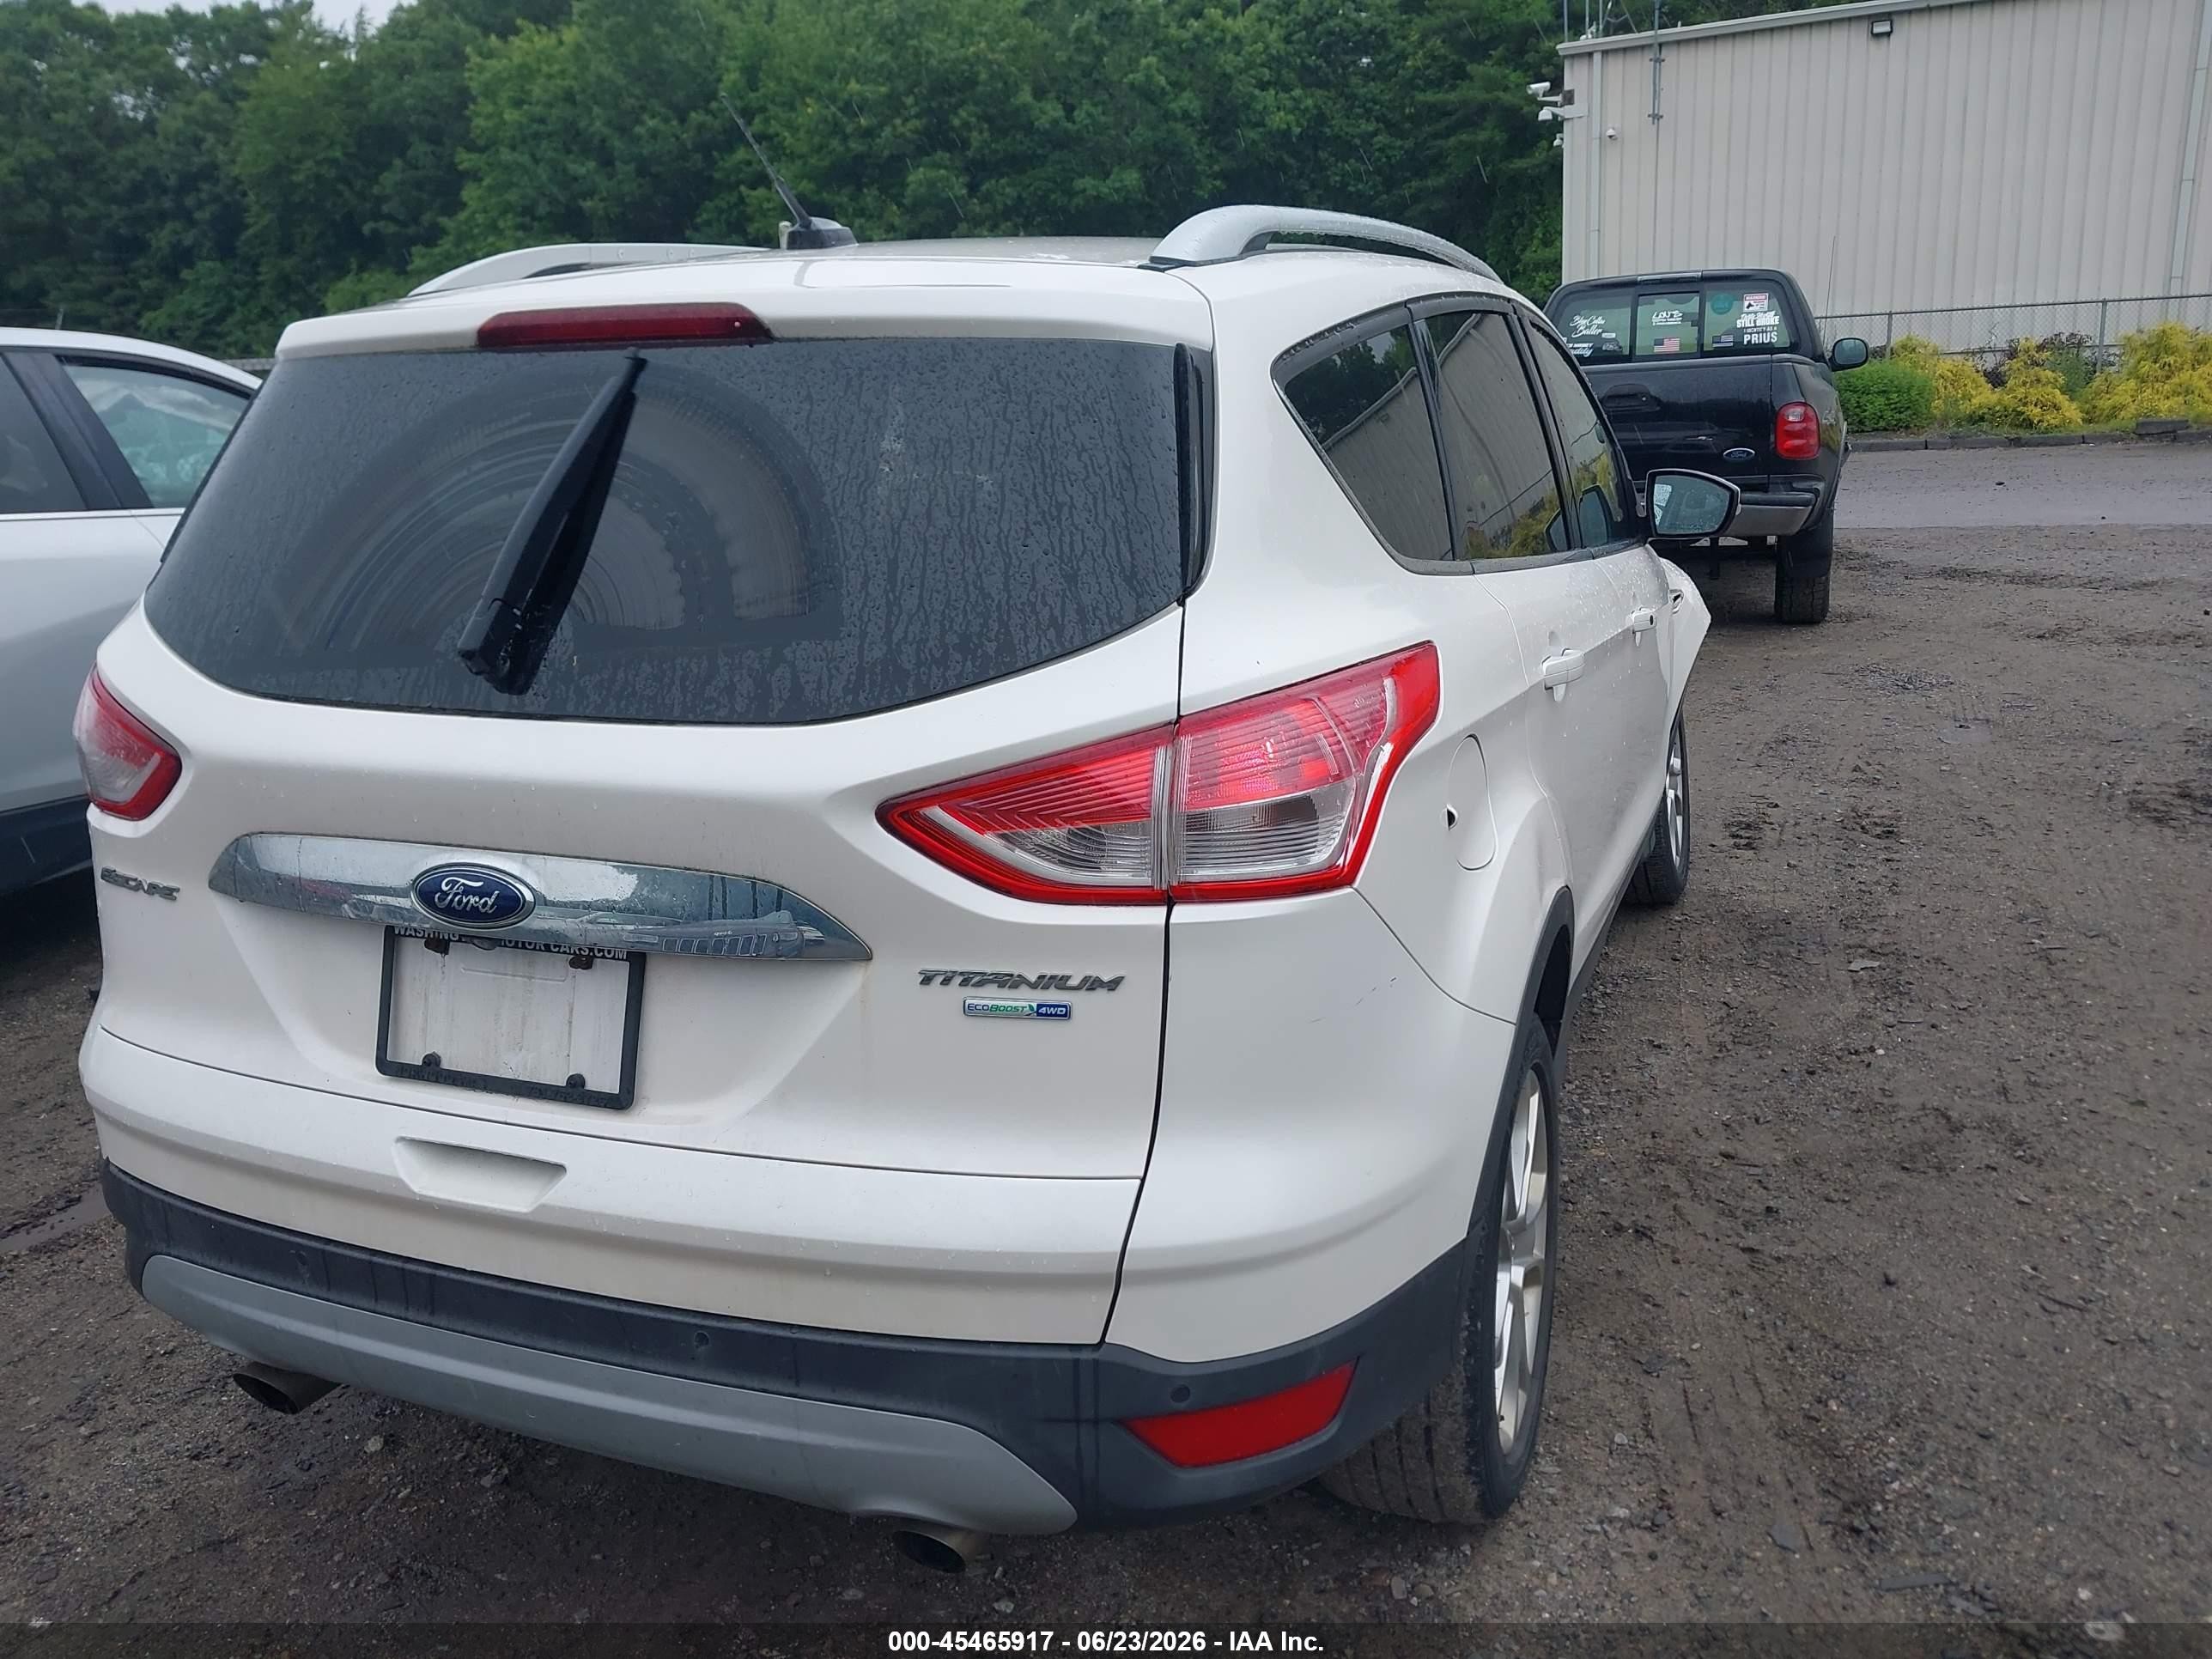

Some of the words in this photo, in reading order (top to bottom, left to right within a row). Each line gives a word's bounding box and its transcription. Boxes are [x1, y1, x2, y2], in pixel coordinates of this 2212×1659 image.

[1743, 331, 1778, 345] PRIUS
[434, 877, 500, 914] Ford
[918, 969, 1126, 992] TITANIUM
[1038, 1006, 1066, 1015] 4WD
